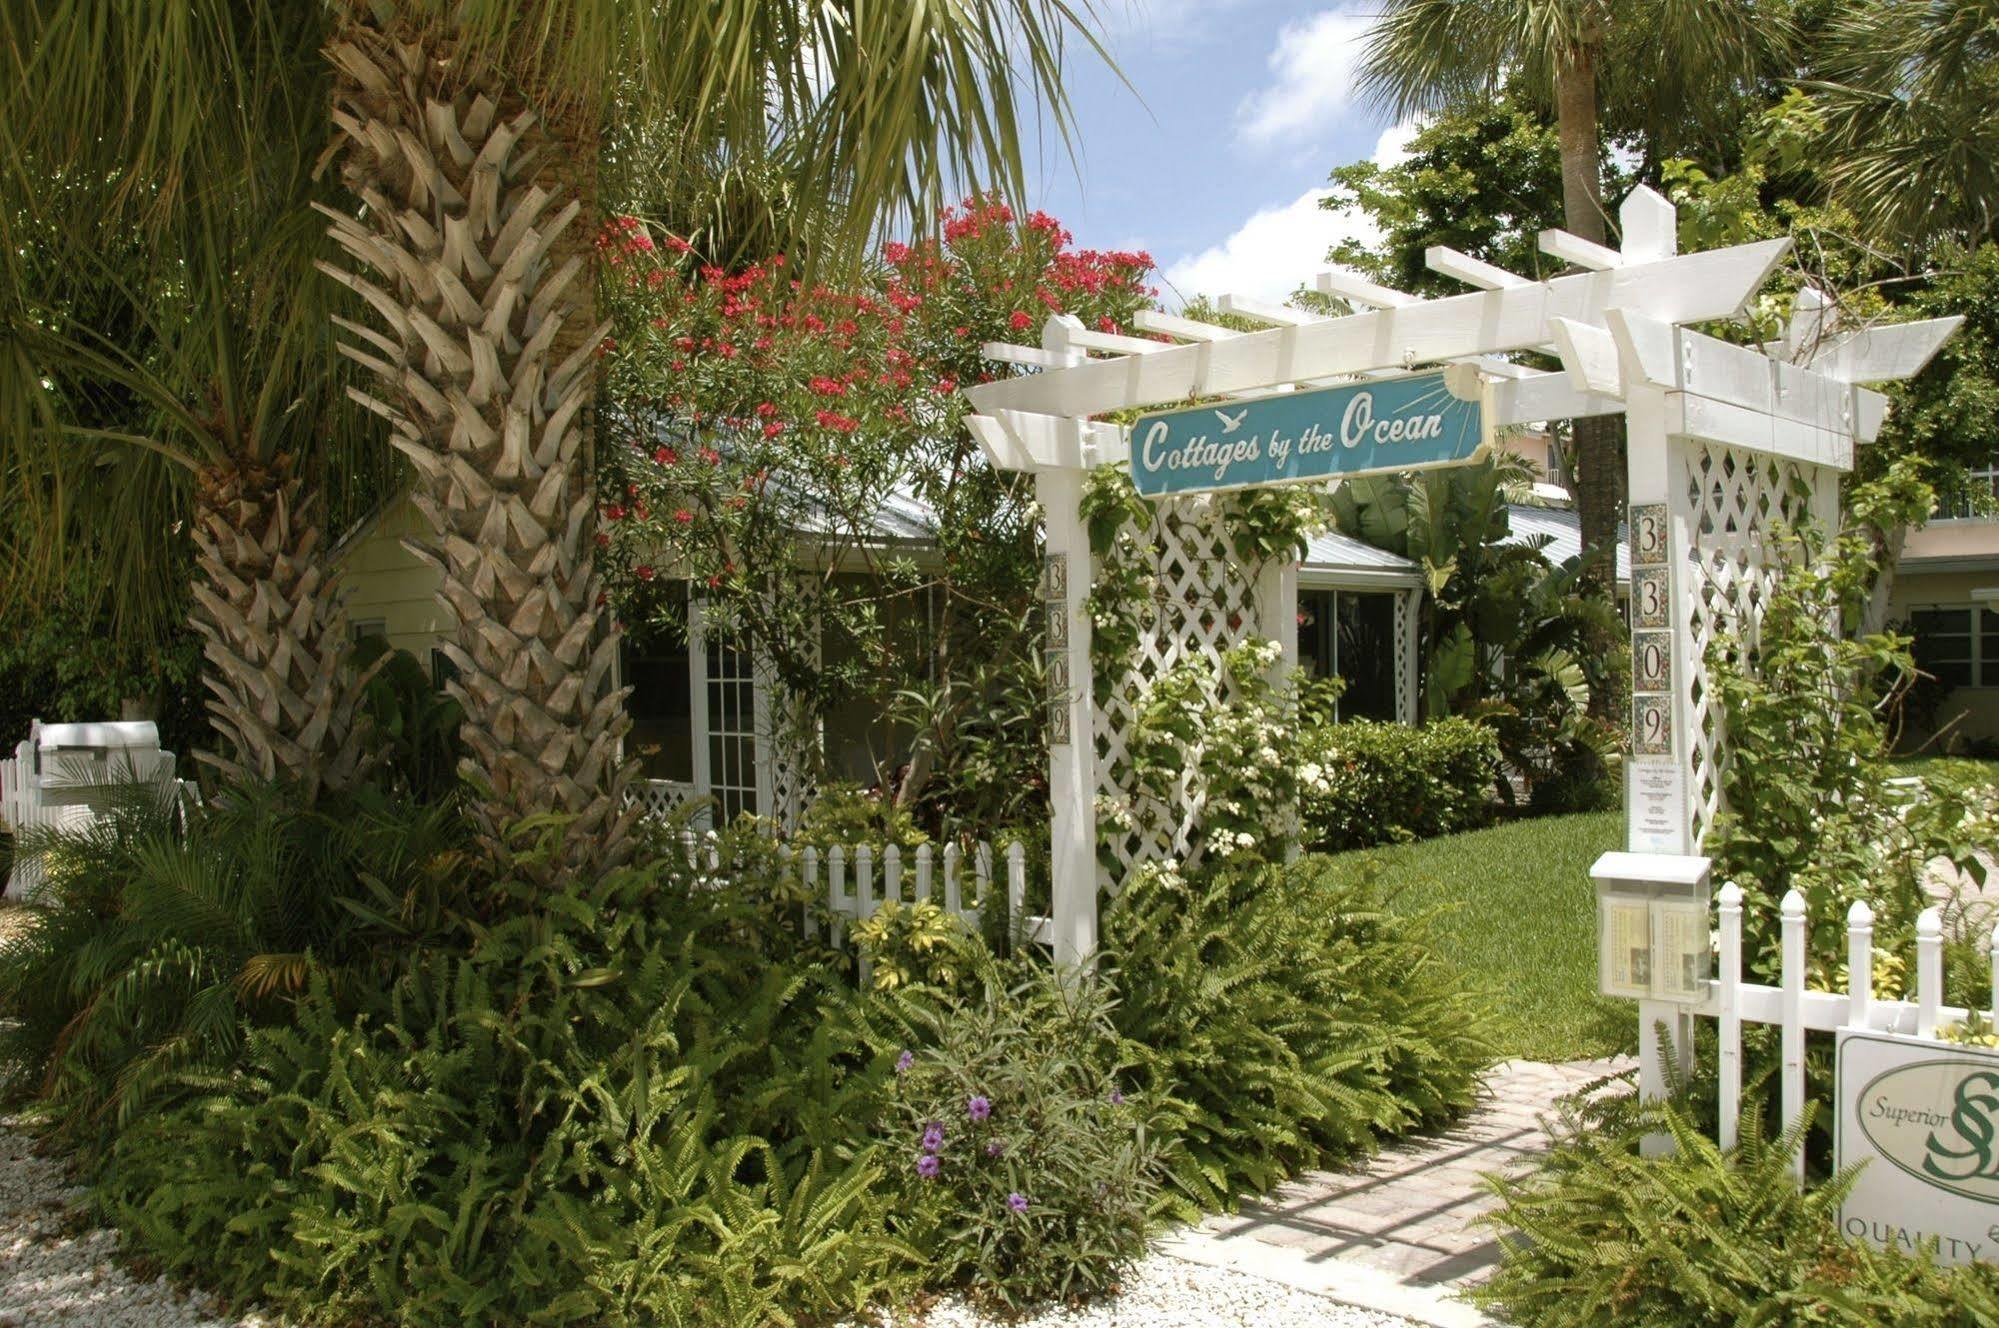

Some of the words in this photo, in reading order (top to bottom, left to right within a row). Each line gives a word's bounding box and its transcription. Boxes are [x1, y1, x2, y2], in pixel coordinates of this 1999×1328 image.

[1143, 421, 1260, 481] Cottages
[1268, 429, 1292, 470] by
[1298, 423, 1333, 455] the
[1340, 392, 1443, 448] Ocean
[1870, 1096, 1949, 1127] Superior
[1922, 1072, 1999, 1181] SS
